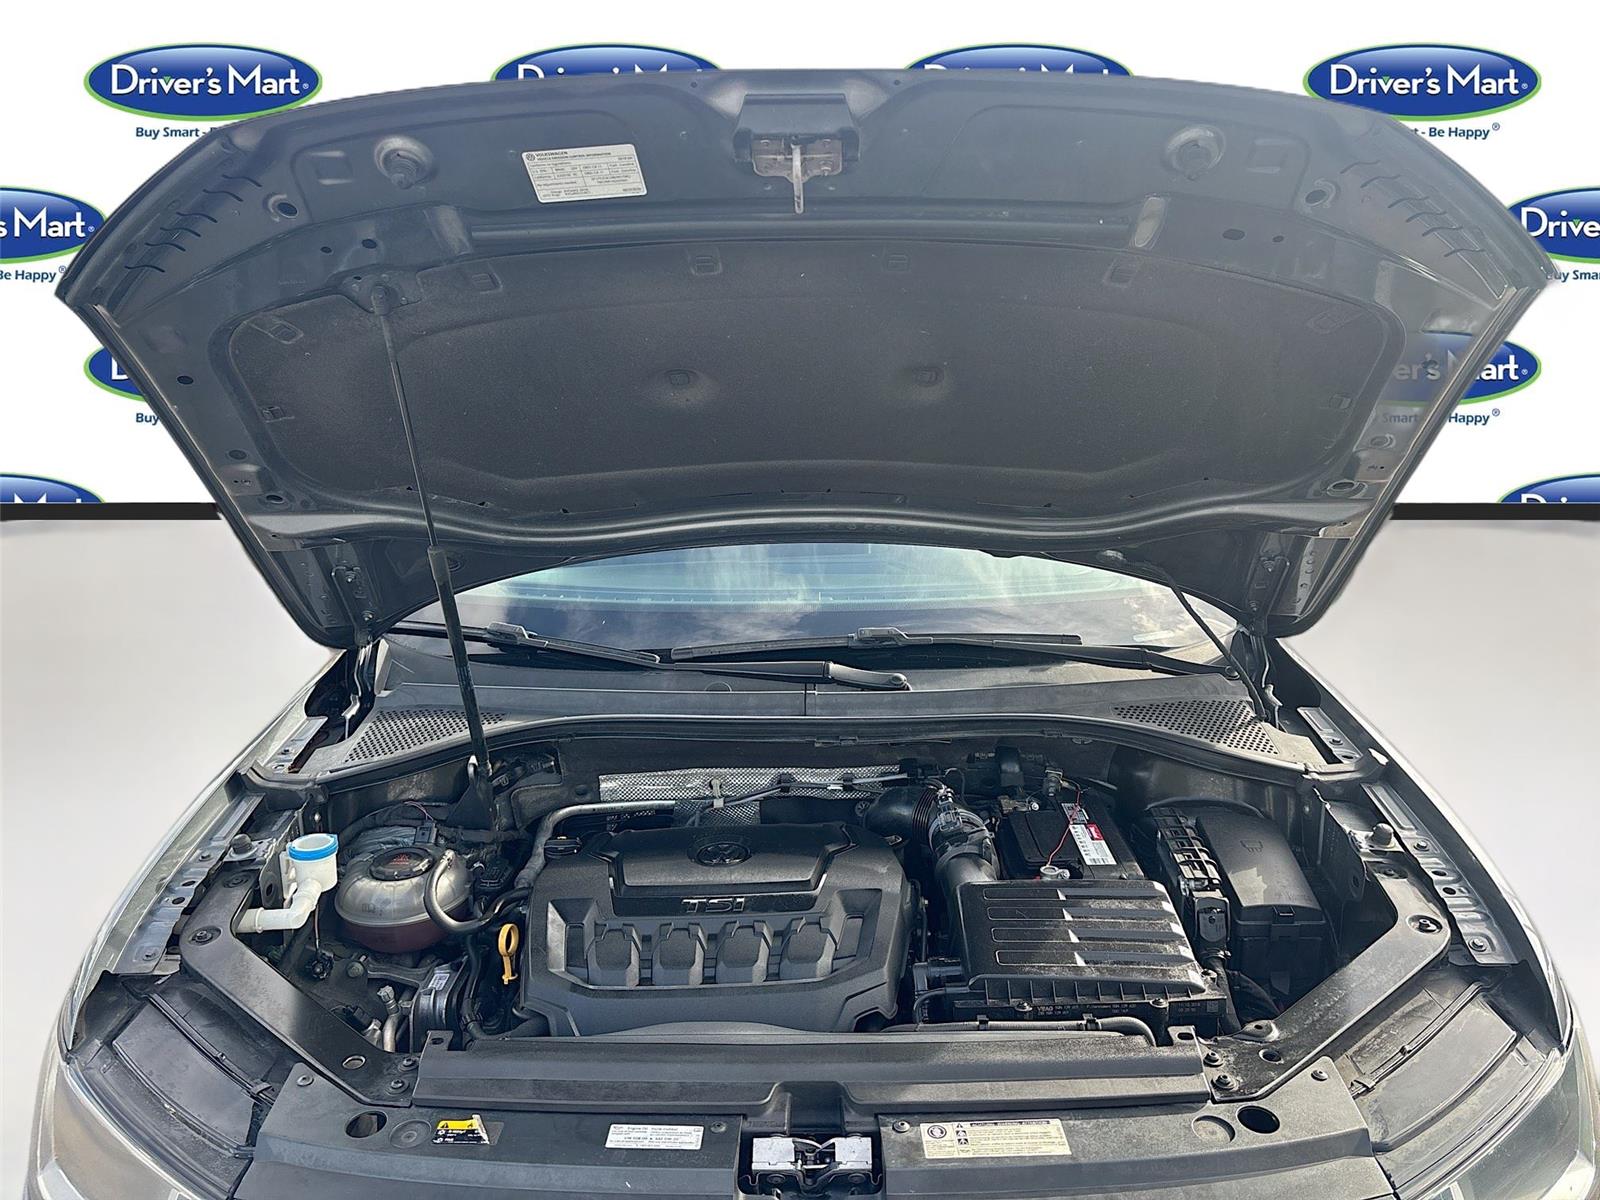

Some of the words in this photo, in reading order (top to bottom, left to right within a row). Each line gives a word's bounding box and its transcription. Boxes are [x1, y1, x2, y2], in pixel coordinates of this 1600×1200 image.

[111, 64, 222, 95] Driver's
[1330, 64, 1441, 95] Driver's
[135, 127, 160, 140] Buy
[163, 127, 200, 137] Smart
[1428, 127, 1445, 137] Be
[135, 412, 160, 426] Buy
[681, 897, 745, 913] TSI
